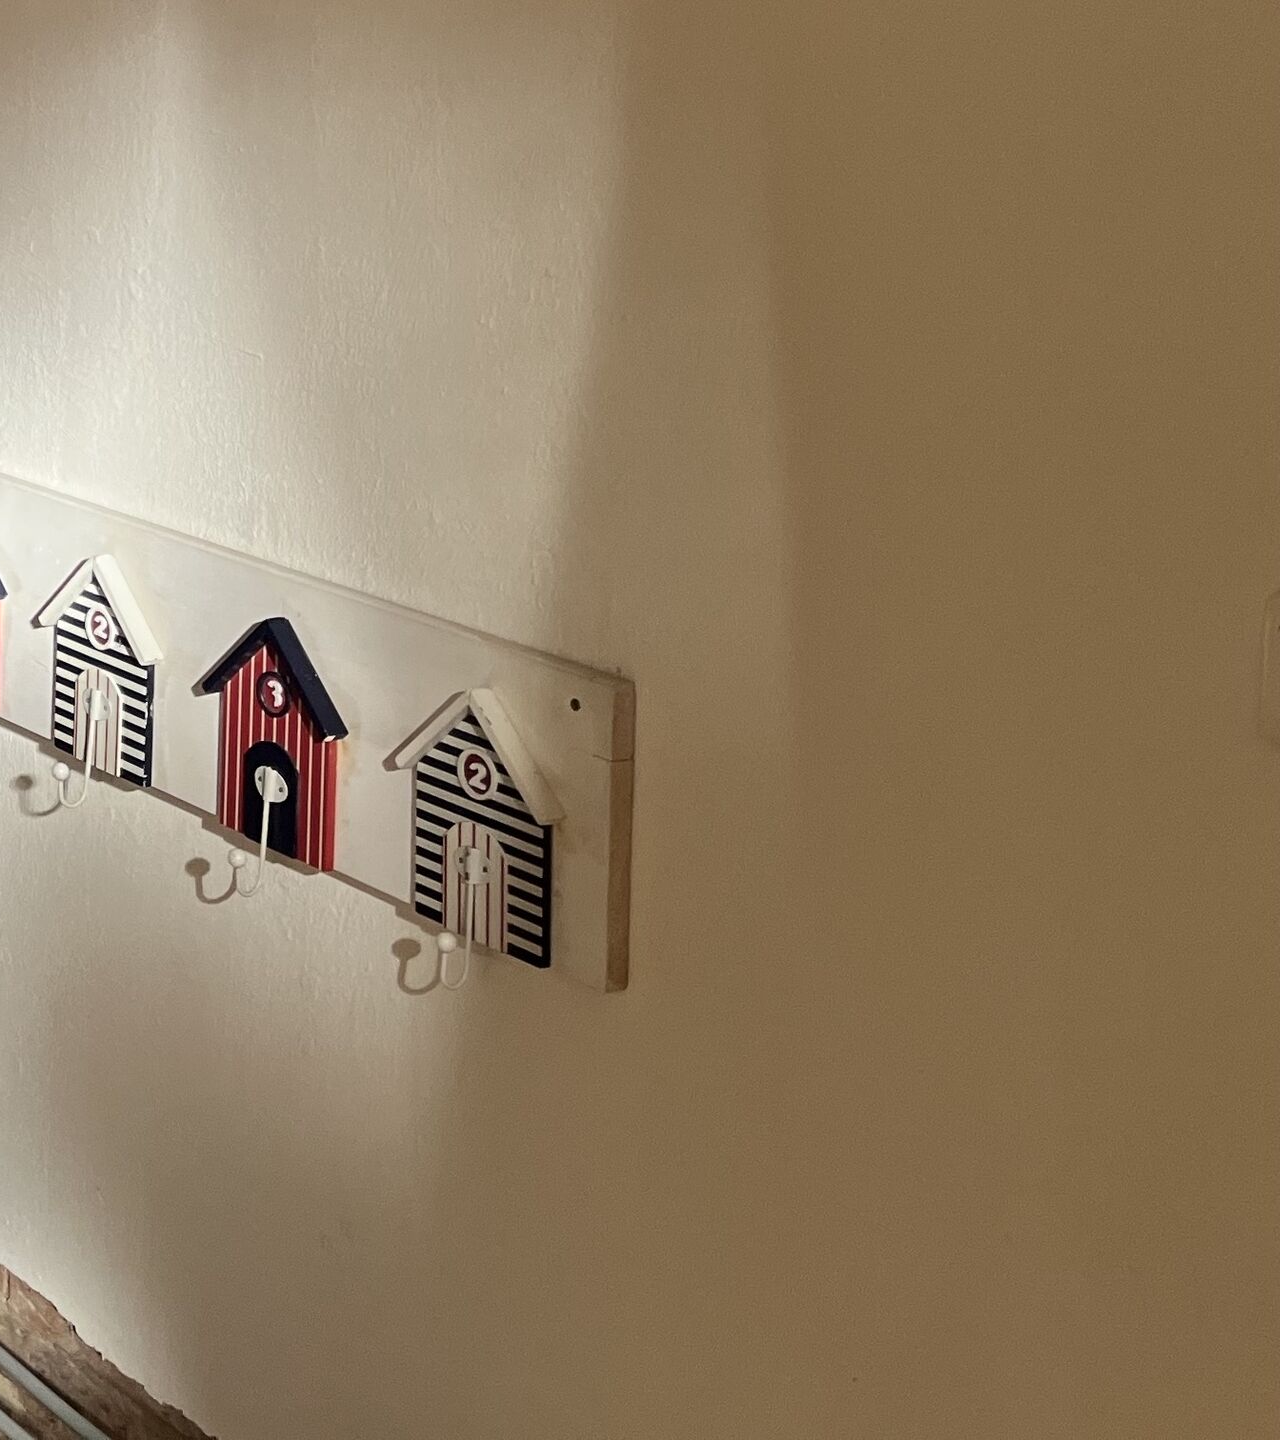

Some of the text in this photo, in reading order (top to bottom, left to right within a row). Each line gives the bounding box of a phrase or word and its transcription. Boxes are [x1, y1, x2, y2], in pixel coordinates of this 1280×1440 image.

[92, 615, 109, 641] 2
[266, 679, 284, 708] 3
[468, 762, 487, 791] 2
